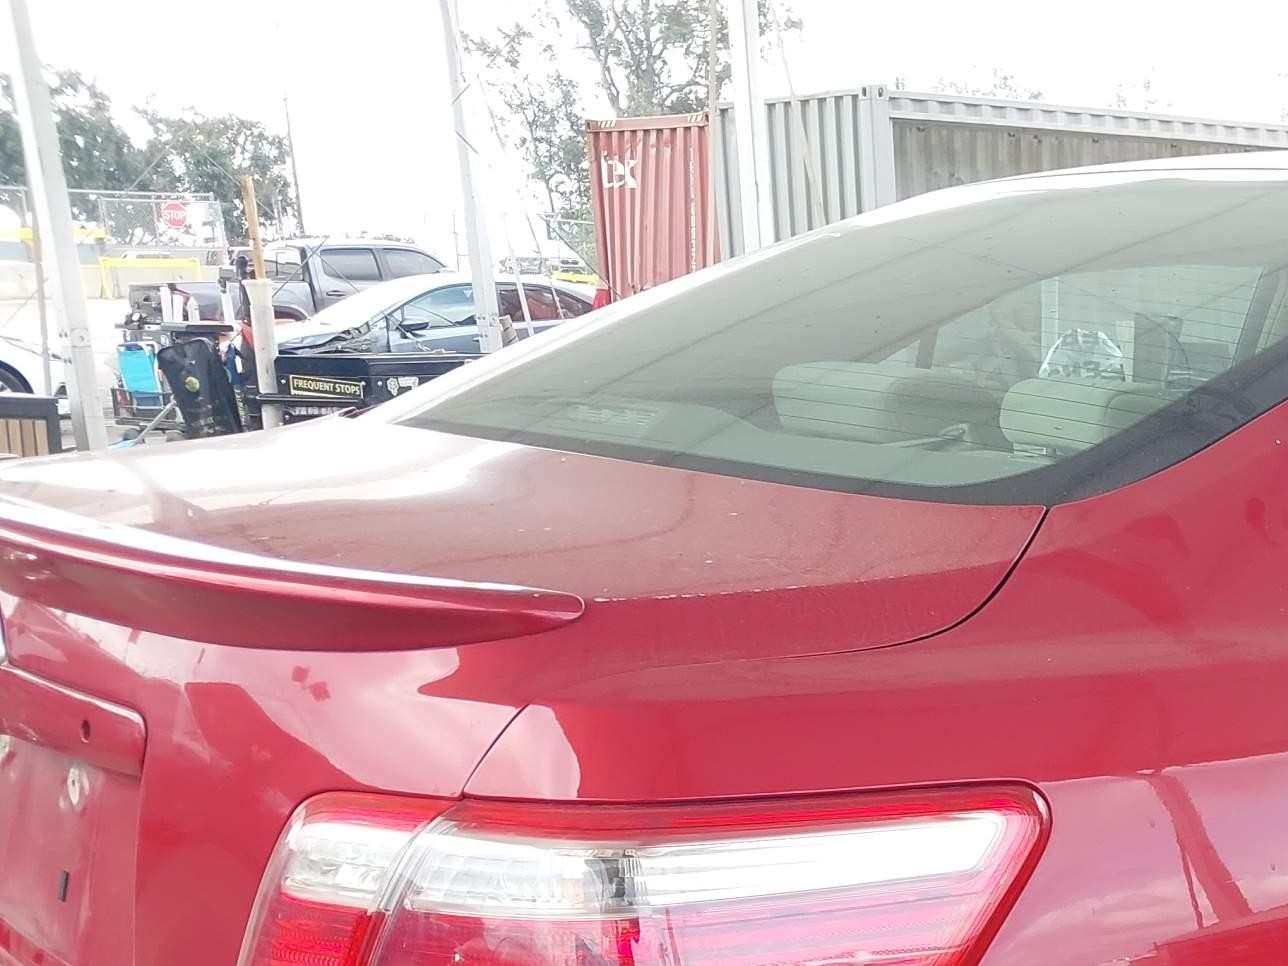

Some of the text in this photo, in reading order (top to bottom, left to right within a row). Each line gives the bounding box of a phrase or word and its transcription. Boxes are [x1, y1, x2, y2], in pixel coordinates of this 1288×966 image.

[164, 210, 186, 221] STOP
[293, 378, 360, 395] FREQUENT STOPS
